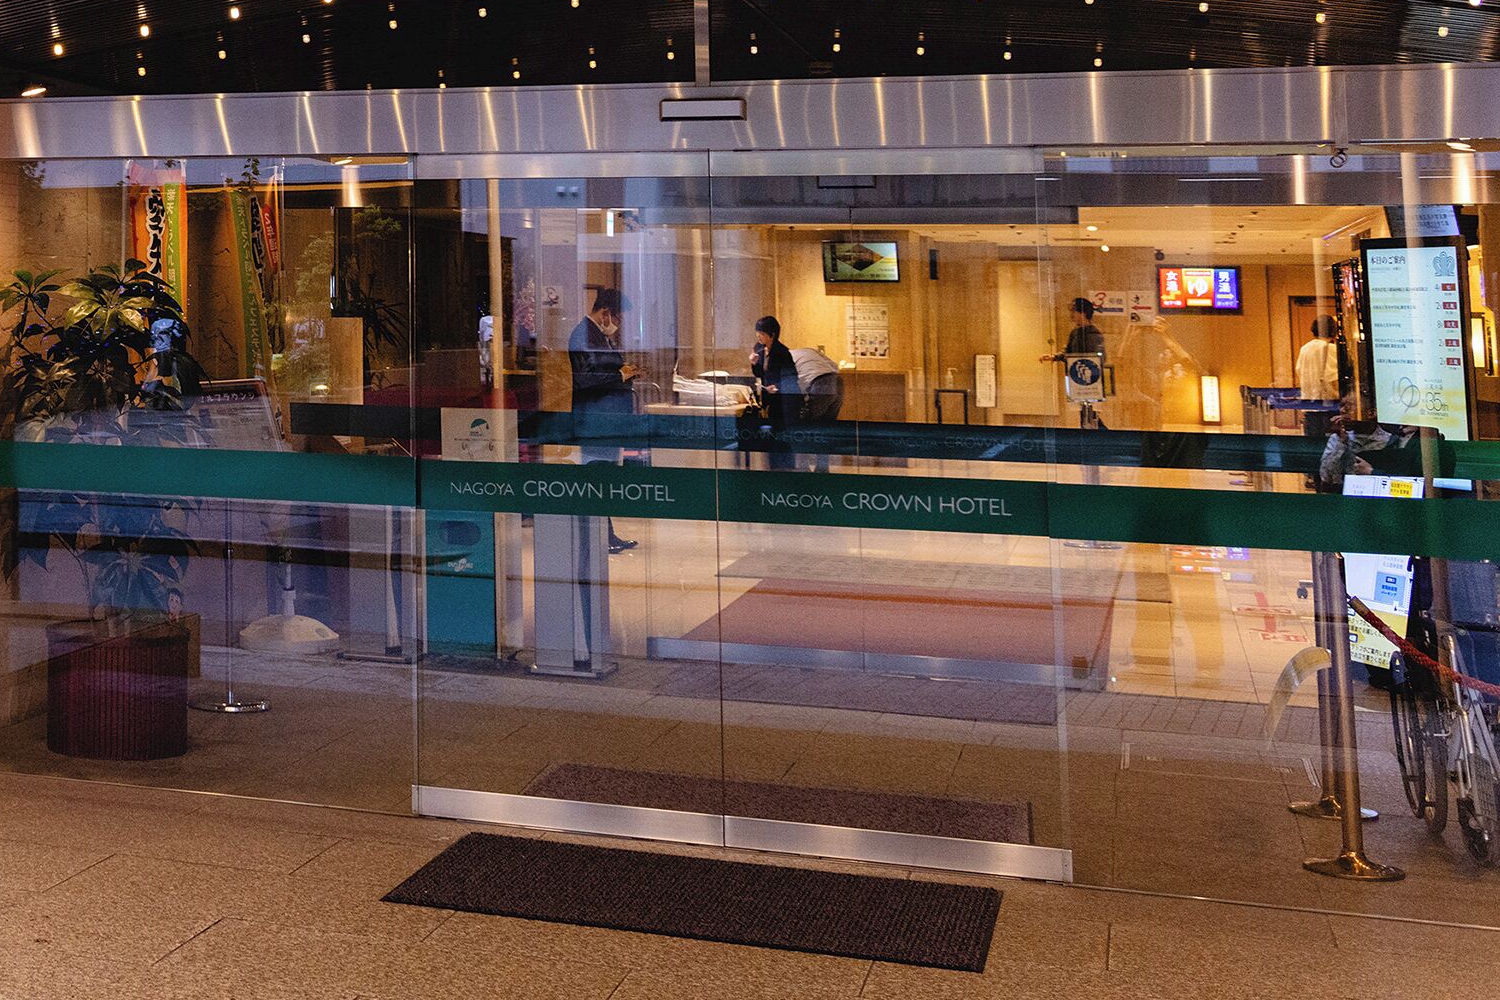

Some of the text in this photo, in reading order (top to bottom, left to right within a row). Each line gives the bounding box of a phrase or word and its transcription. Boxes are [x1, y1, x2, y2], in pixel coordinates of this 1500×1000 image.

[1187, 279, 1209, 297] ゆ
[721, 428, 780, 442] CROWN
[449, 480, 676, 502] NAGOYA CROWN HOTEL
[761, 492, 1013, 517] NAGOYA CROWN HOTEL
